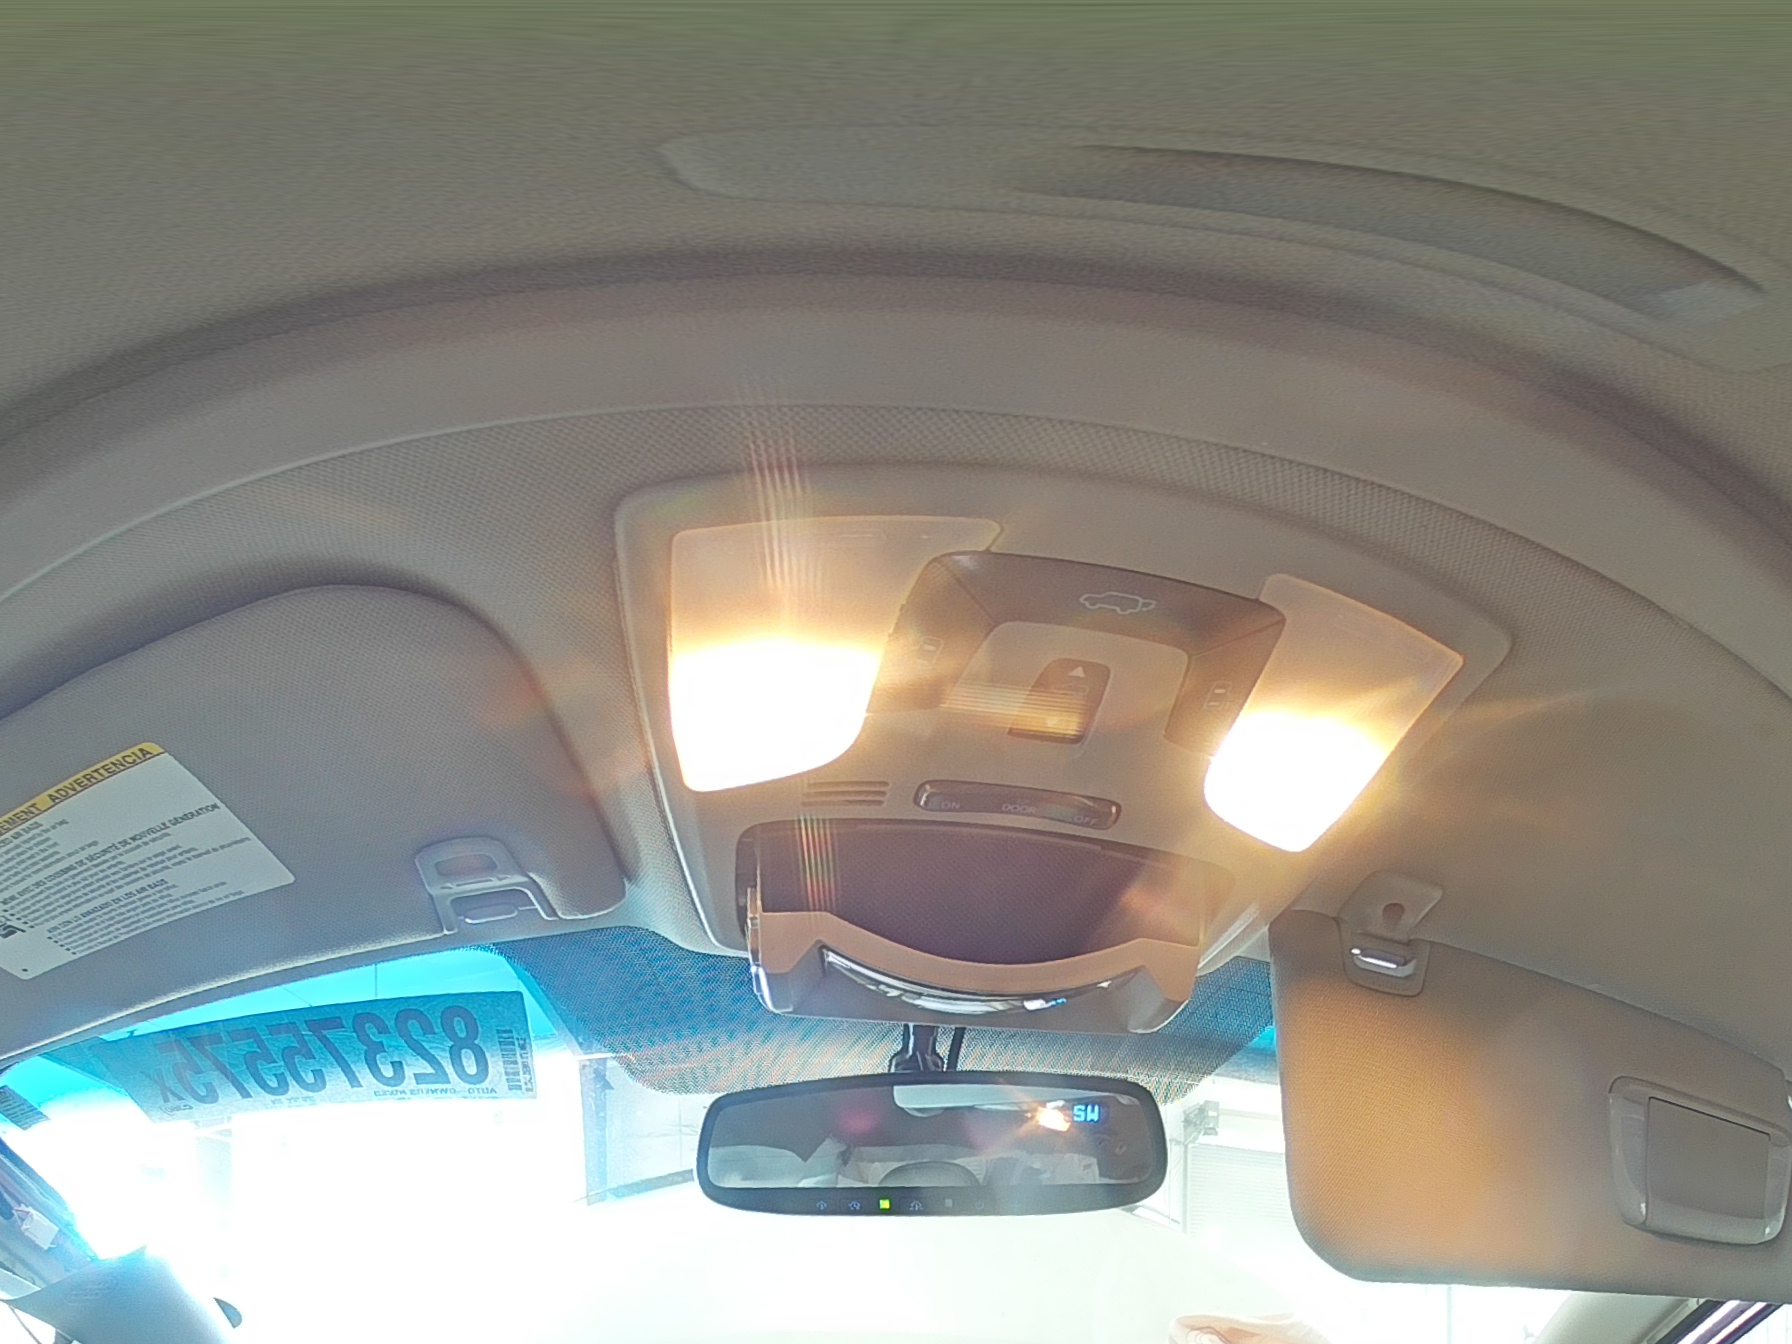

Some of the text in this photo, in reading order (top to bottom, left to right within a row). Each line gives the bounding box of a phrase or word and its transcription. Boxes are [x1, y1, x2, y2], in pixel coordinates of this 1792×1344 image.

[46, 747, 154, 804] ADVERTENCIA
[941, 802, 1099, 825] ON DOOR OFF
[1073, 1104, 1099, 1122] SW
